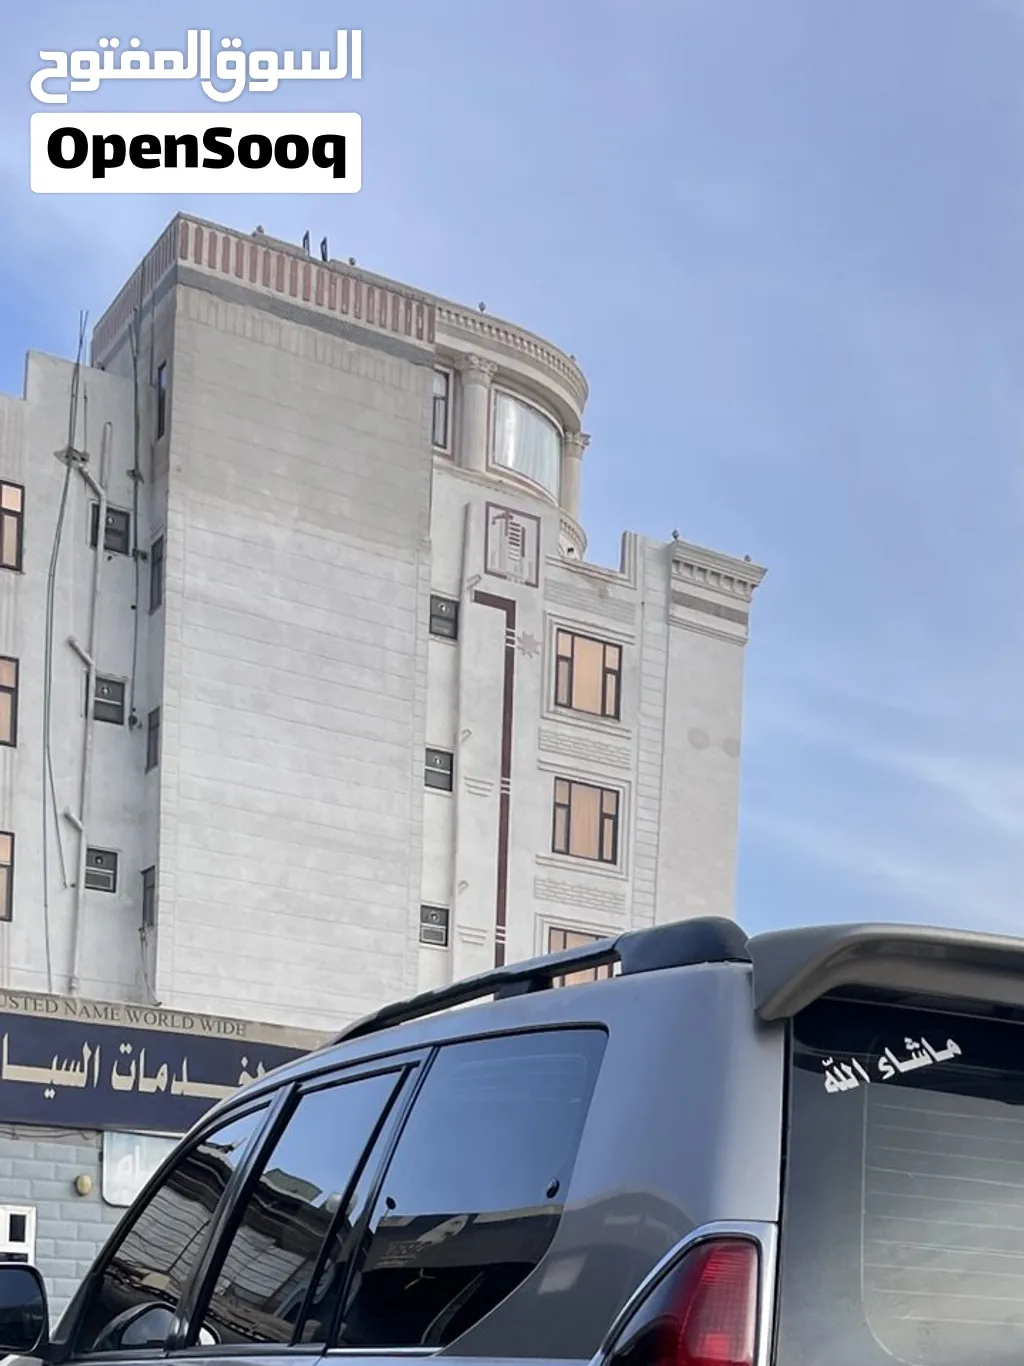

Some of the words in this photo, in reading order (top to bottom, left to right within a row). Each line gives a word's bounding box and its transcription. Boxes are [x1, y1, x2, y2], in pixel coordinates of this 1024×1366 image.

[64, 1000, 120, 1021] NAME
[124, 1008, 195, 1030] WORLD
[200, 1017, 247, 1037] WIDE
[877, 1036, 962, 1081] ماشاء
